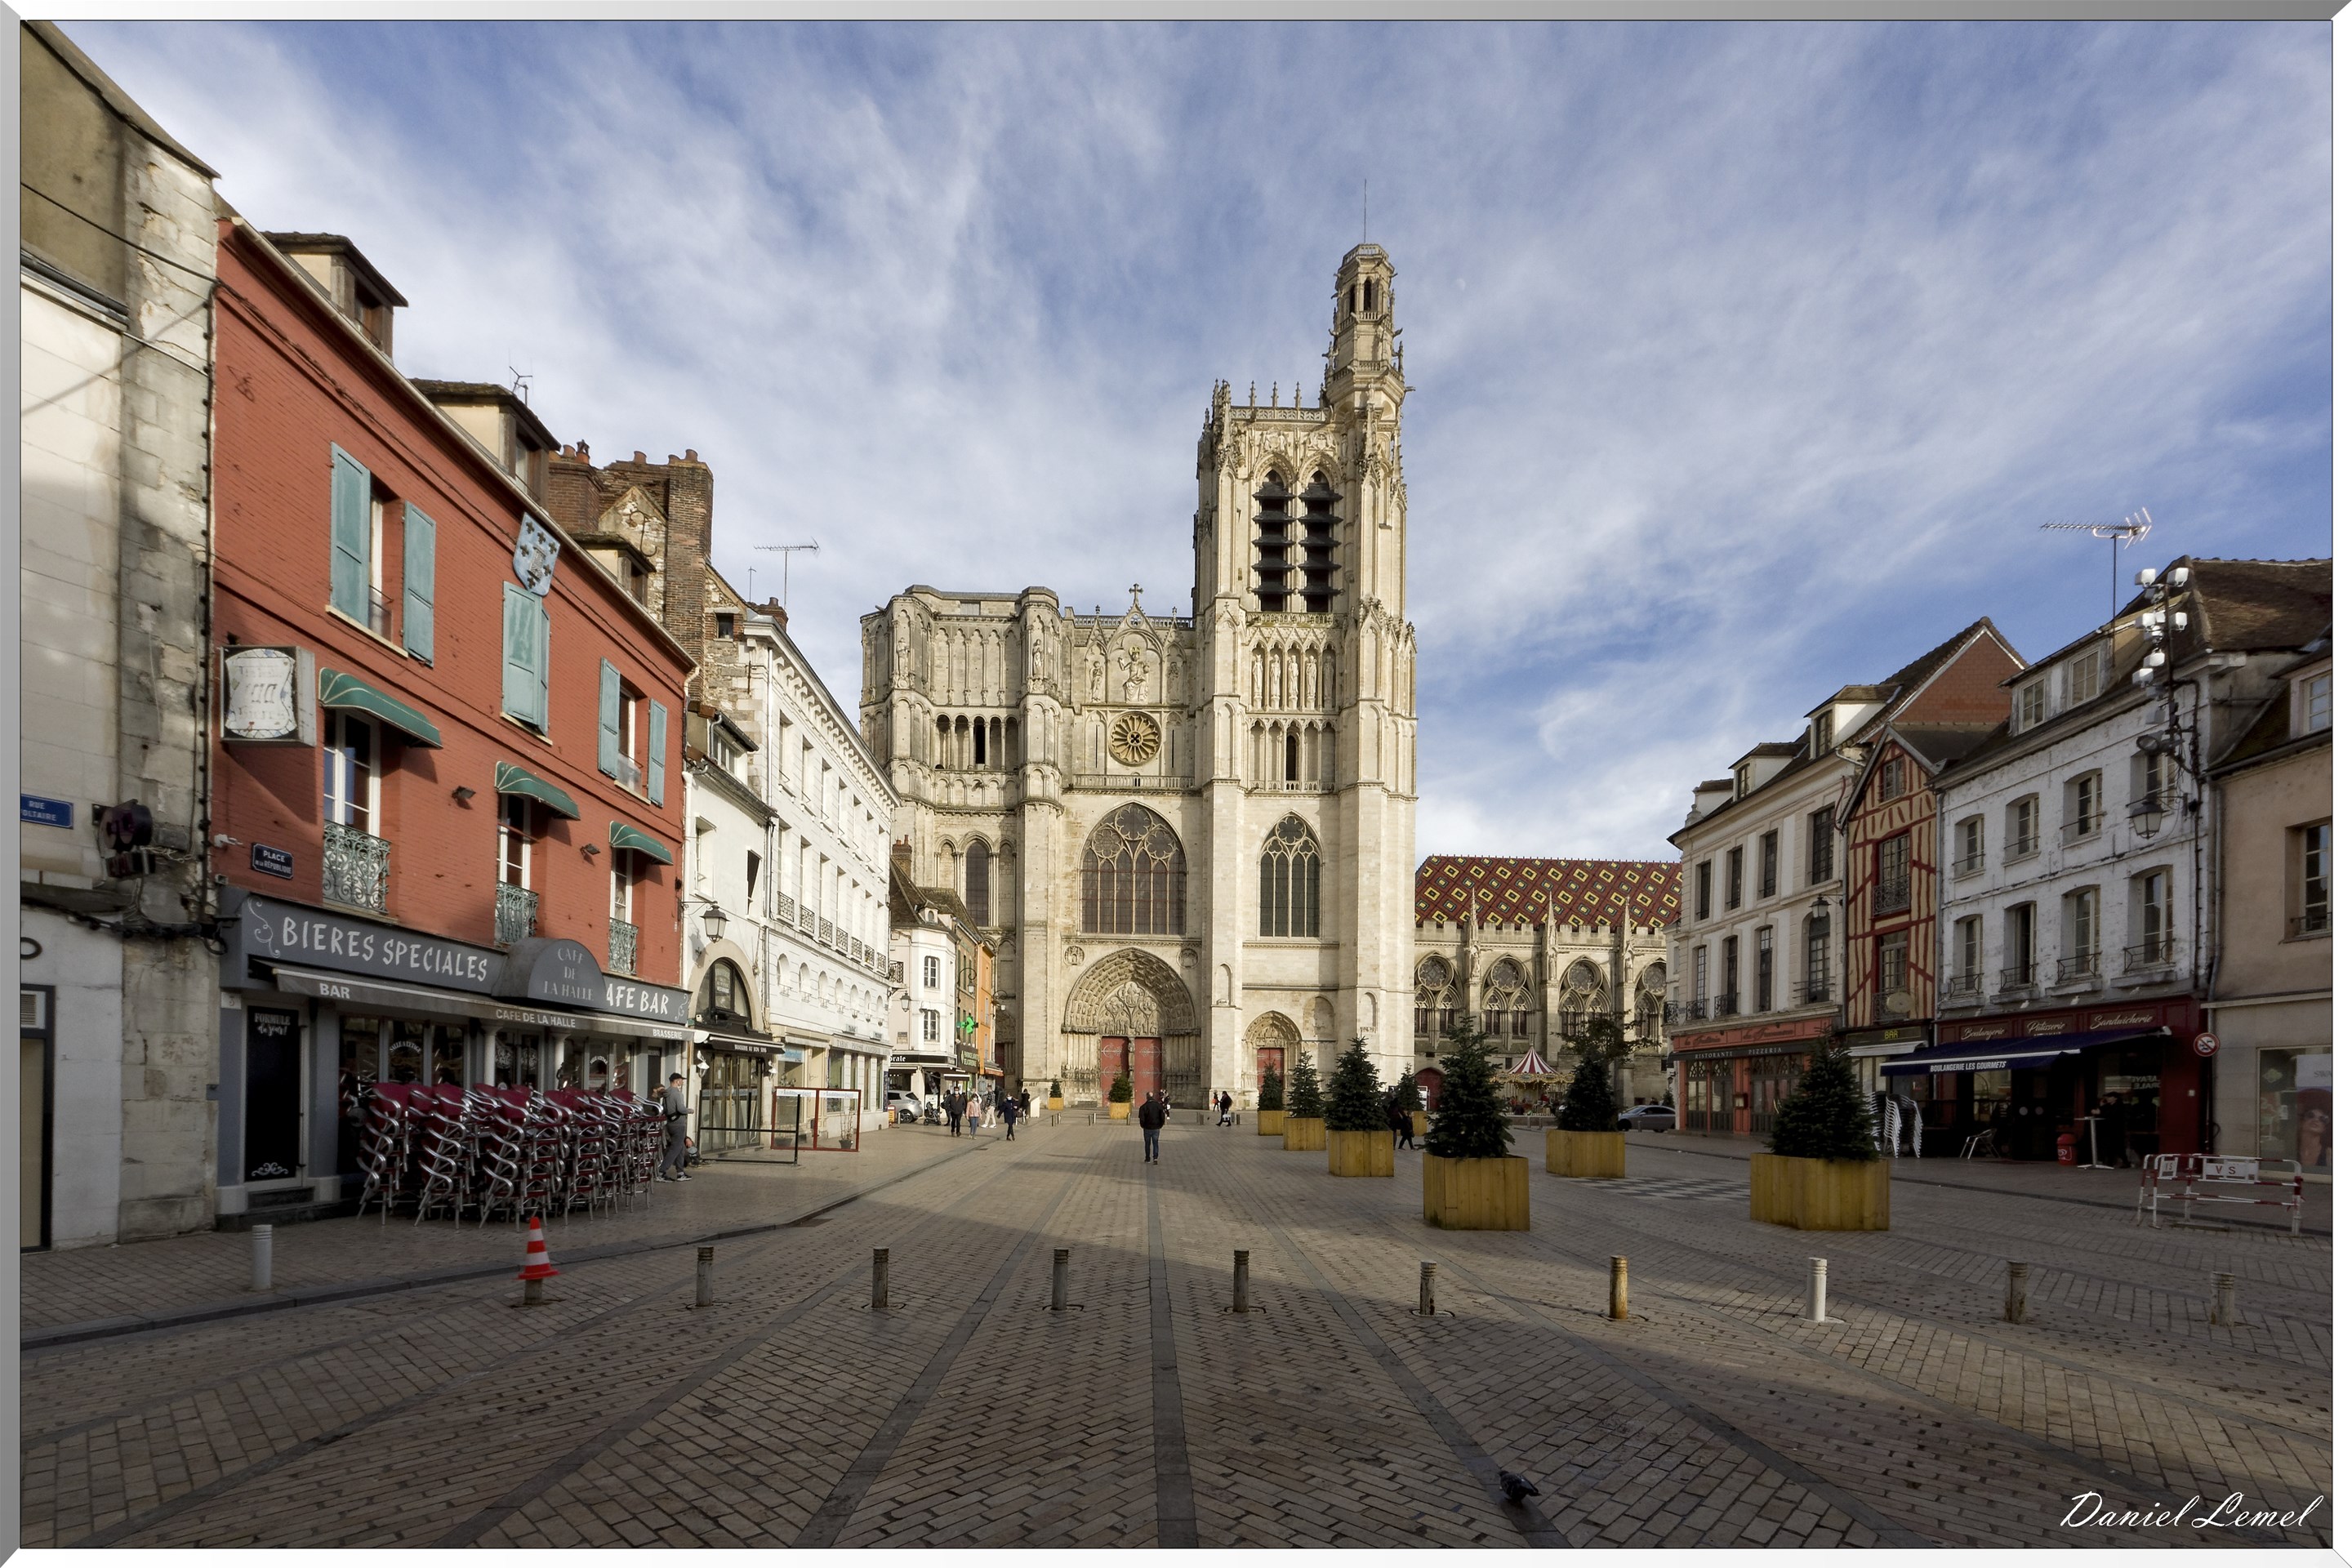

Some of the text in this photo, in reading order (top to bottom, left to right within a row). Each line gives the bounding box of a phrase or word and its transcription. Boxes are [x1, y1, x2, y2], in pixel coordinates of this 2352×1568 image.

[28, 800, 46, 809] RUE
[21, 808, 57, 822] OLTAIRE
[263, 850, 286, 862] PLACE
[283, 916, 488, 982] BIERES SPECIALES
[564, 966, 575, 979] DE
[319, 983, 350, 1000] BAR
[544, 980, 595, 1001] LA HALLE
[606, 983, 669, 1014] AFE BAR
[254, 1013, 291, 1026] FORMULE
[496, 1009, 576, 1028] CAFE DE LA HALLE
[1961, 1027, 2005, 1040] Boulangerie
[2089, 1013, 2154, 1029] Sandwicherie
[653, 1029, 683, 1039] BRASSERIE
[1885, 1031, 1898, 1039] BAR
[1748, 1047, 1782, 1055] PIZZERIA
[1931, 1061, 2007, 1071] BOULANGERIE LES GOURMETS
